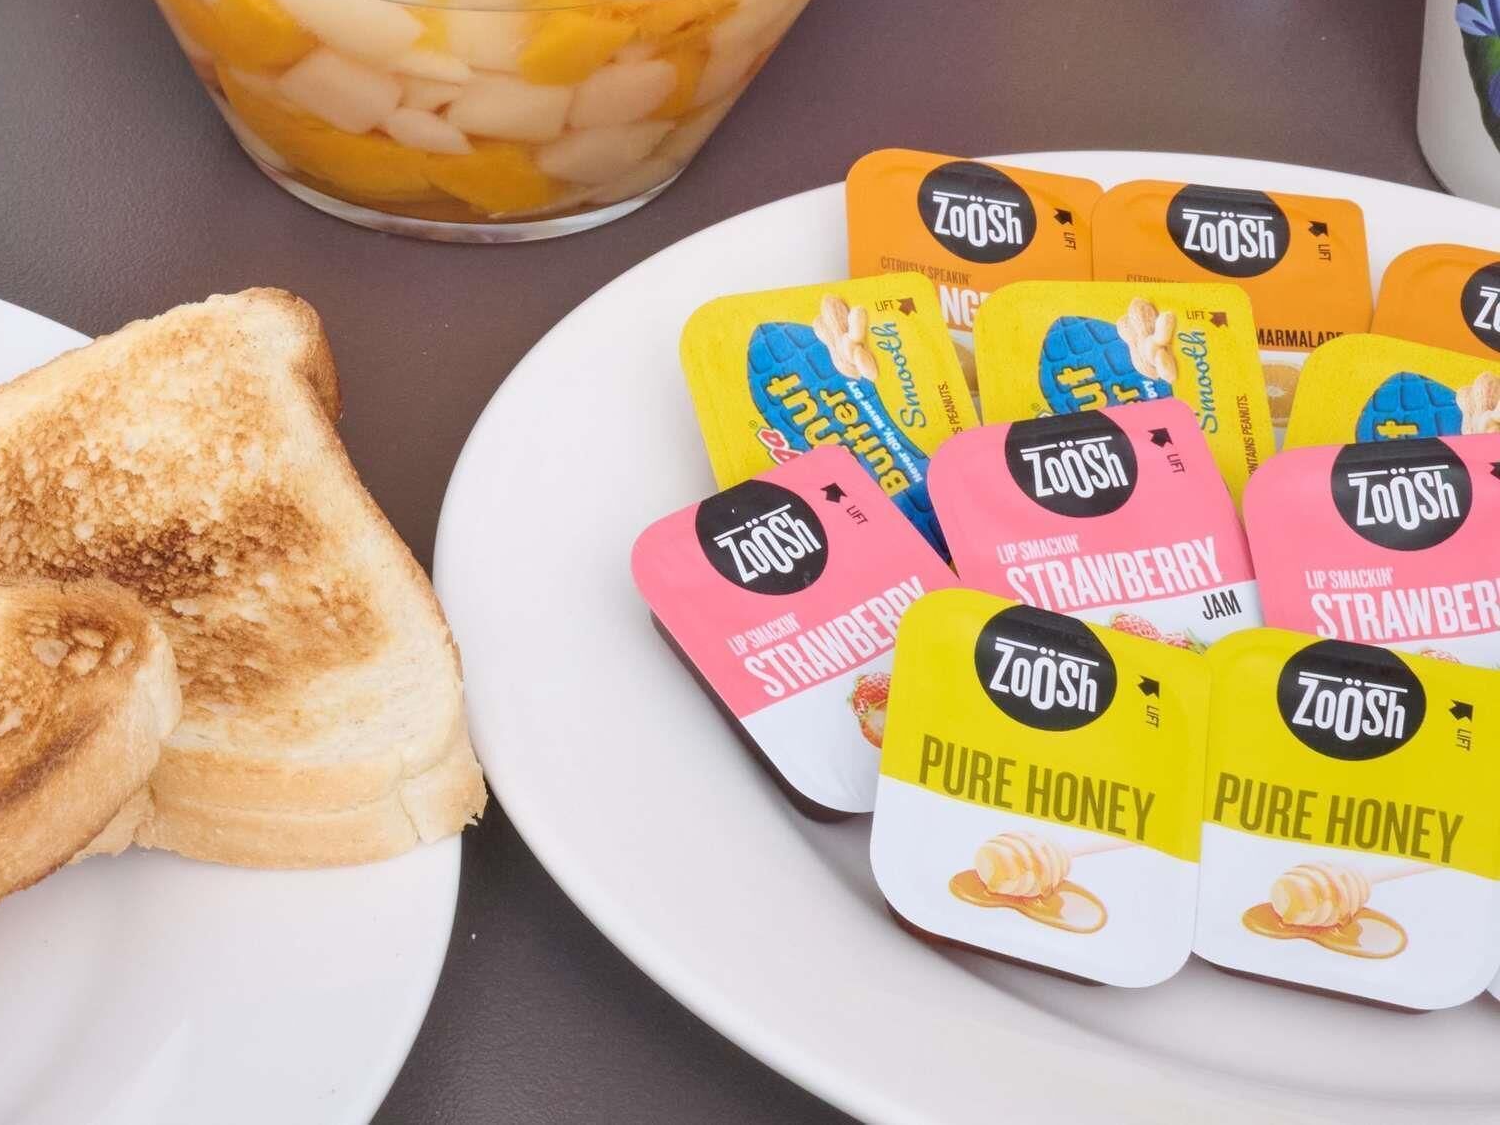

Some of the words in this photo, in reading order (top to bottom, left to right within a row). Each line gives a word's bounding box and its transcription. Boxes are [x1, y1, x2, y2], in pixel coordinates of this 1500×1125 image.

[1064, 230, 1077, 251] LIFT
[1318, 243, 1332, 262] LIFT
[874, 299, 895, 313] LIFT
[1186, 309, 1206, 322] LIFT
[1256, 328, 1345, 349] MARMALA
[870, 322, 926, 429] Smooth
[1178, 328, 1219, 435] Smooth
[1166, 452, 1186, 475] LIFT
[1242, 435, 1260, 477] ONTAINS
[845, 504, 869, 526] LIFT
[995, 543, 1018, 565] LIP
[1006, 535, 1225, 613] STRAWBERRY
[1304, 569, 1329, 591] LIP
[1201, 589, 1243, 621] JAM
[1310, 575, 1500, 643] STRAWBER
[726, 634, 749, 658] LIP
[1146, 704, 1160, 729] LIFT
[1455, 727, 1474, 753] LIFT
[918, 733, 1018, 809] PURE
[1024, 763, 1157, 842] HONEY
[1212, 770, 1319, 842] PURE
[1324, 794, 1465, 864] HONEY
